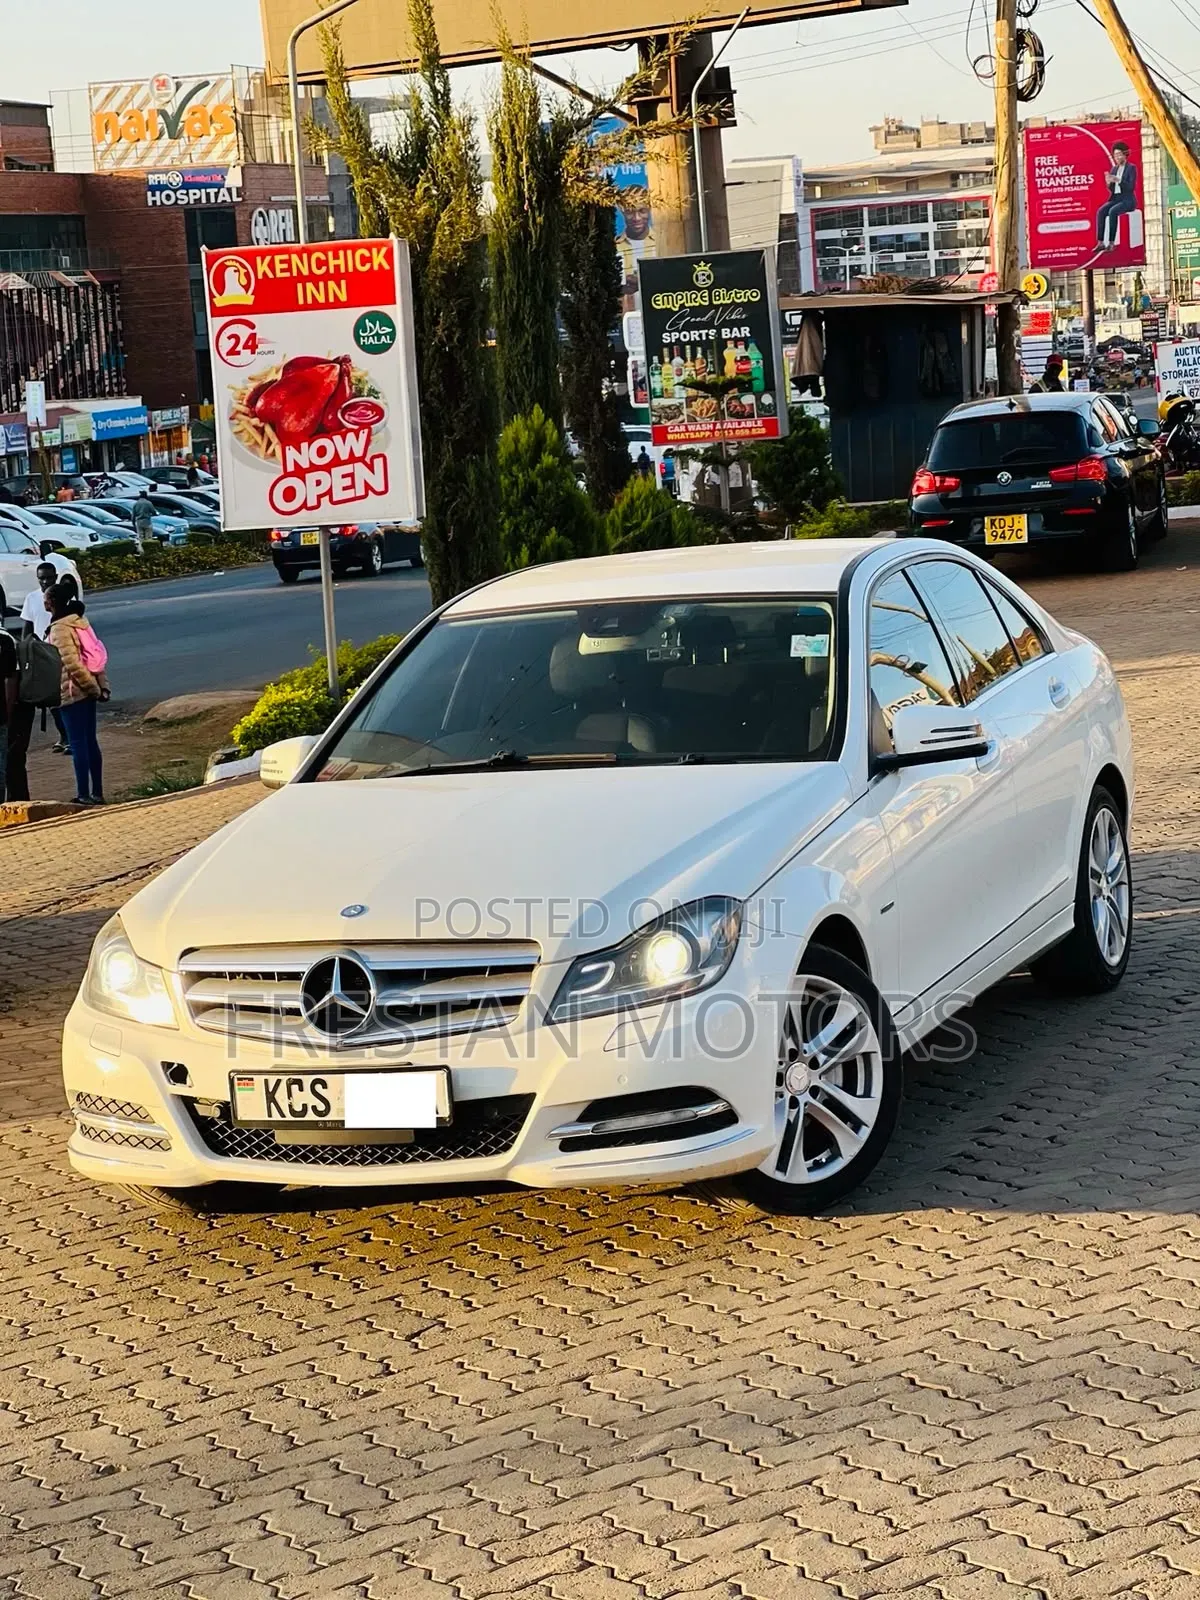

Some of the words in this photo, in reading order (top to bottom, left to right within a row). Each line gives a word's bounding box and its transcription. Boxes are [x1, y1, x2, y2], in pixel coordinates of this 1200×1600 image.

[93, 81, 236, 143] naivas
[621, 163, 642, 175] the
[1034, 155, 1059, 166] FREE
[147, 173, 168, 185] RFH
[1035, 165, 1075, 178] MONEY
[1035, 174, 1095, 188] TRANSFERS
[146, 187, 243, 206] HOSPITAL
[1038, 187, 1052, 195] WITH
[268, 208, 295, 243] RFH
[256, 246, 390, 279] KENCHICK
[296, 280, 348, 305] INN
[651, 289, 709, 311] EMPIRE
[712, 287, 760, 305] Bistro
[359, 318, 393, 336] حلال
[665, 308, 715, 330] Good
[360, 335, 393, 345] HALAL
[662, 328, 717, 343] SPORTS
[721, 326, 751, 339] BAR
[226, 332, 259, 357] 24
[1161, 368, 1200, 380] STORAGE
[666, 431, 713, 441] WHATSAPP:
[667, 425, 686, 433] CAR
[687, 423, 713, 431] WASH
[286, 428, 369, 472] NOW
[272, 457, 386, 512] OPEN
[990, 517, 1015, 530] KDJ
[990, 529, 1023, 541] 947C
[263, 1077, 332, 1119] KCS
